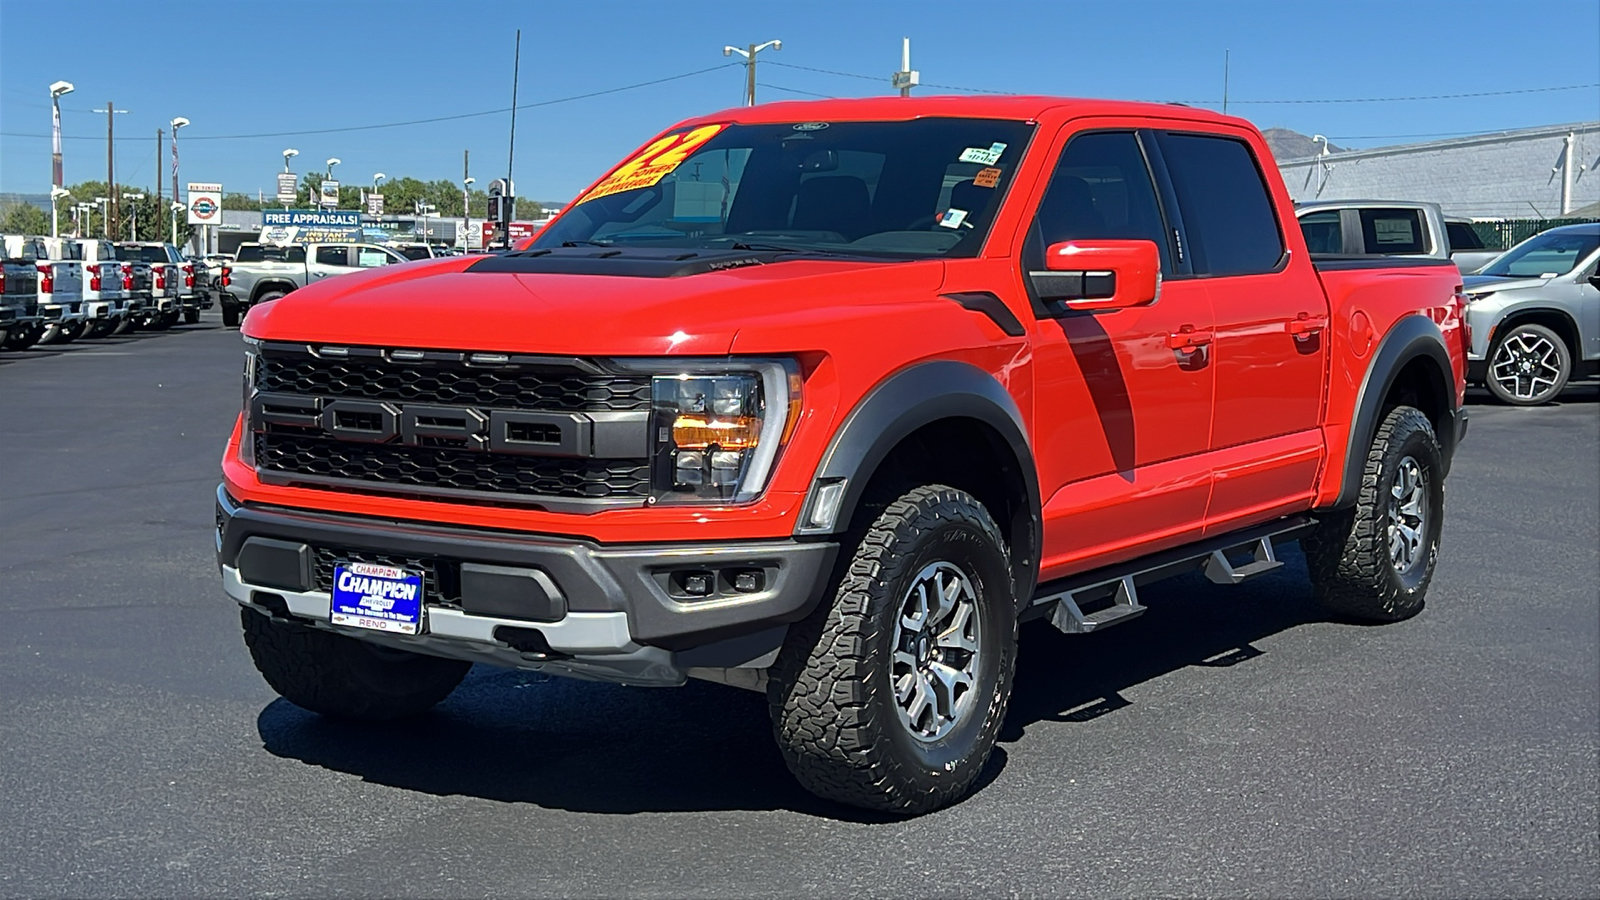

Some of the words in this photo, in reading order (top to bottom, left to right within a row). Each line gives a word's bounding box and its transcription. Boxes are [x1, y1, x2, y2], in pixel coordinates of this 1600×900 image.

[628, 163, 677, 180] POWER
[265, 213, 291, 224] FREE
[292, 214, 358, 225] APPRAISALS!
[252, 388, 593, 458] FORD
[356, 565, 398, 577] CHAMPION
[338, 571, 417, 601] CHAMPION
[362, 598, 392, 607] CHEVROLET
[359, 618, 387, 629] RENO
